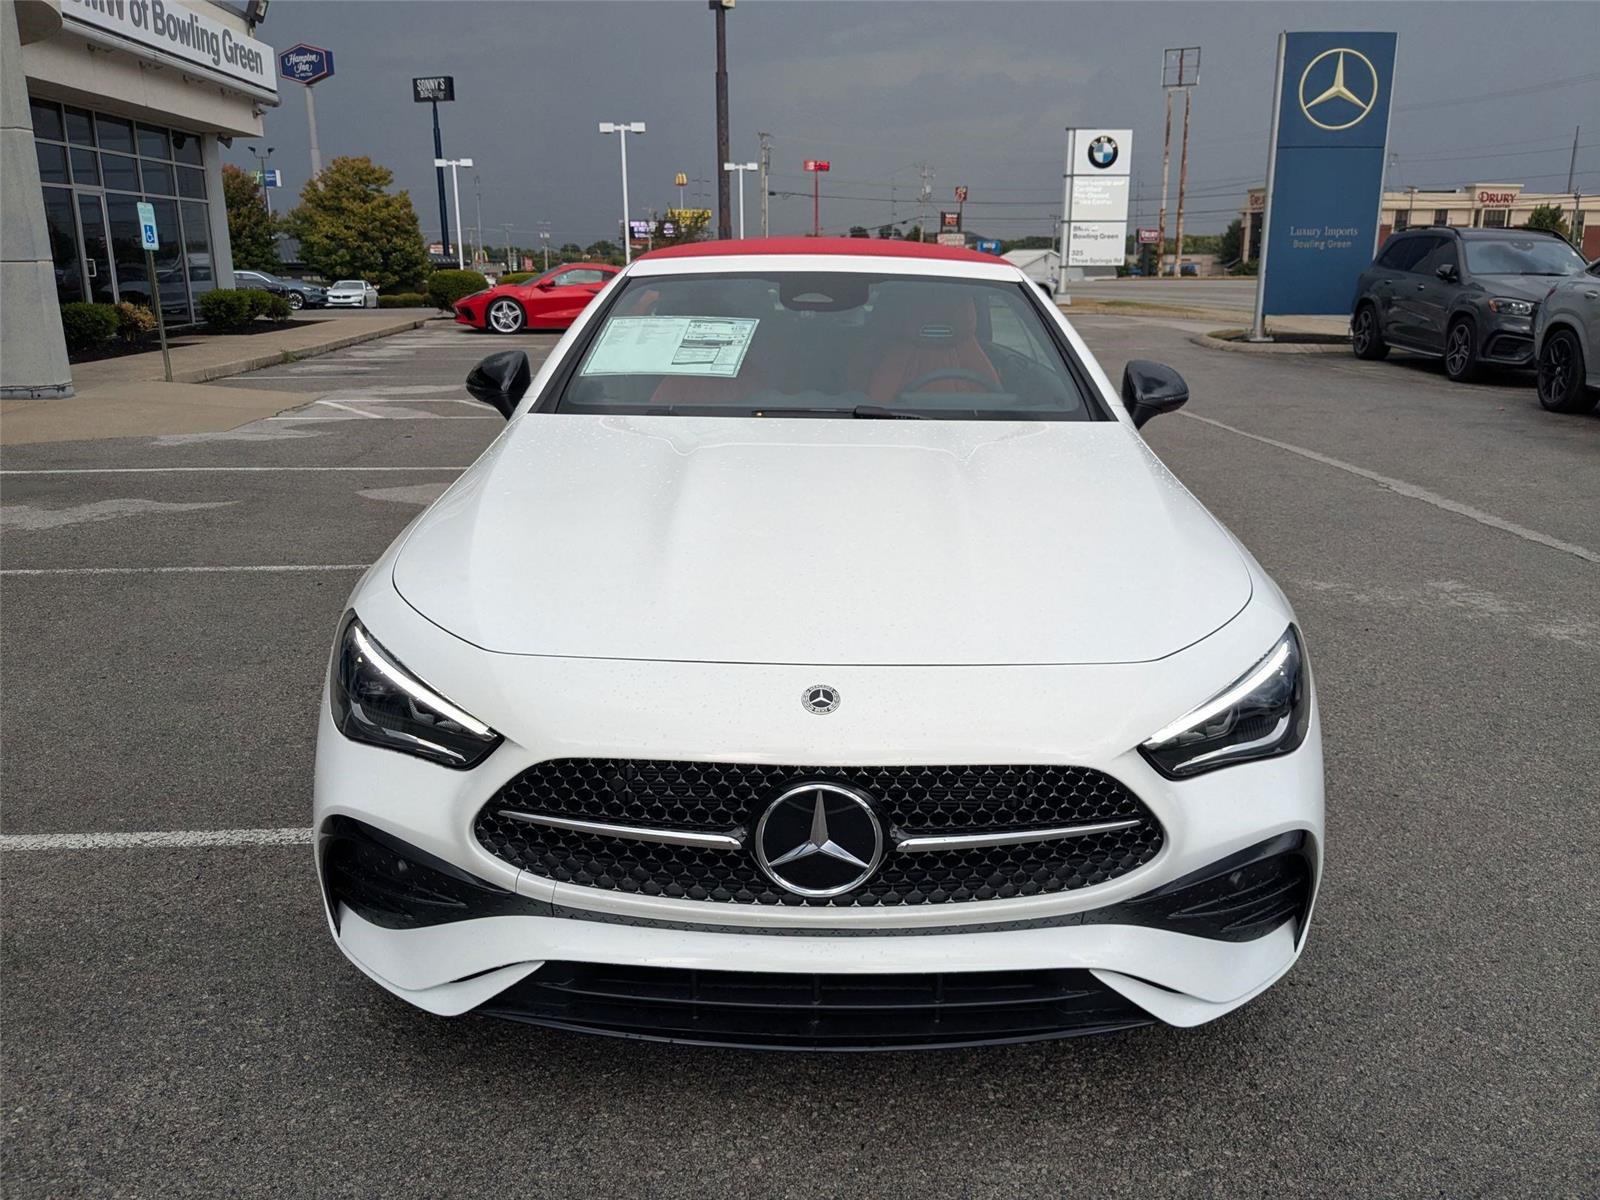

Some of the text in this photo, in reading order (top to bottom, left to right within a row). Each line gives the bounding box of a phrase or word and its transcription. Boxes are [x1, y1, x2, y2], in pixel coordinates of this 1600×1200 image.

[129, 0, 149, 30] of
[152, 0, 220, 66] Bowling
[222, 28, 264, 75] Green
[285, 53, 320, 66] Hampton
[294, 62, 313, 73] Inn
[1477, 191, 1517, 203] DRURY
[1289, 225, 1358, 238] Luxury Imports
[1293, 240, 1352, 250] Bowling Green
